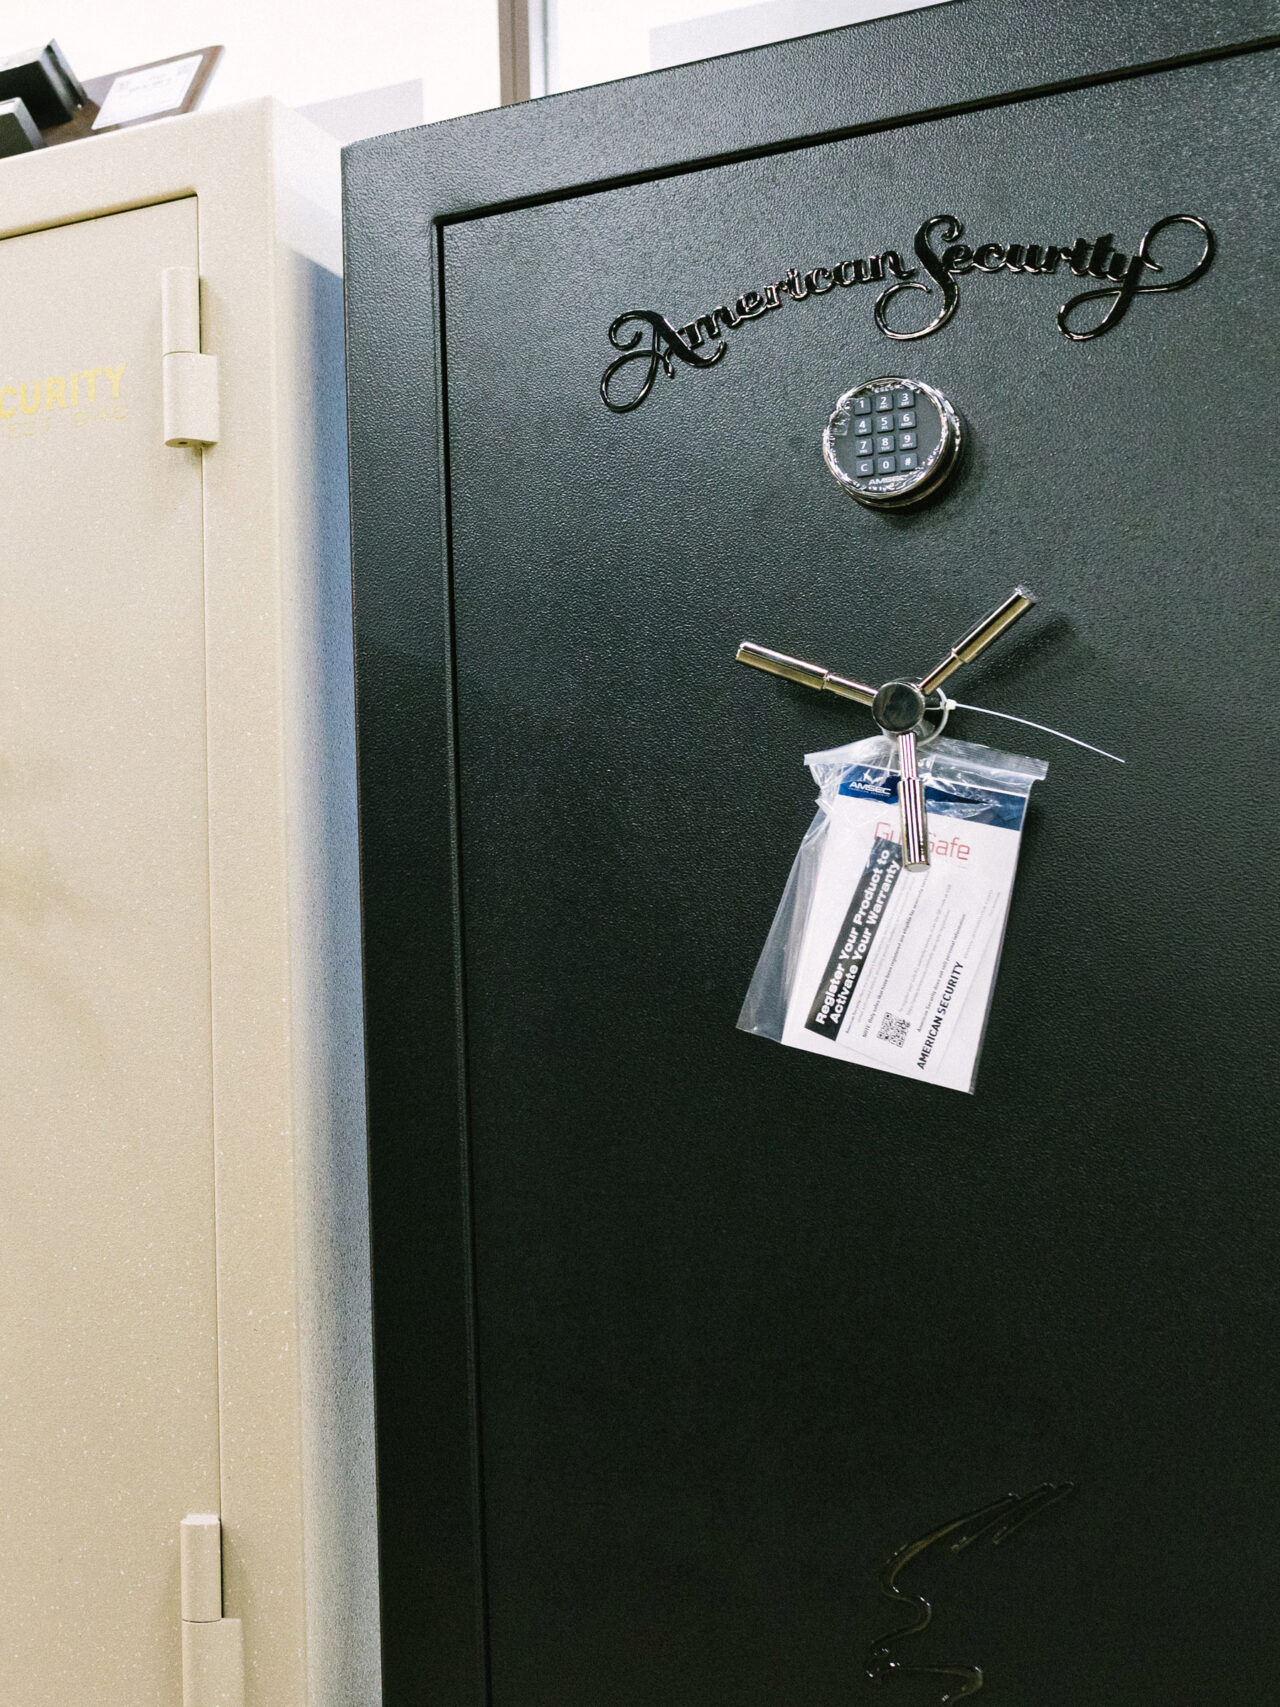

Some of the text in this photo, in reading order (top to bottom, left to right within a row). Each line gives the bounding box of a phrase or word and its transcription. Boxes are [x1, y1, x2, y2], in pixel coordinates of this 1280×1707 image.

[599, 212, 1215, 414] American Security
[849, 780, 891, 796] AMSEC
[873, 821, 903, 845] Gu
[813, 961, 849, 1025] Register
[837, 925, 861, 962] Your
[851, 865, 884, 926] Product
[874, 847, 891, 866] to
[827, 962, 860, 1024] Activate
[851, 925, 874, 962] Your
[864, 857, 902, 927] Warranty
[915, 1015, 943, 1070] AMERICAN
[935, 960, 964, 1016] SECURITY
